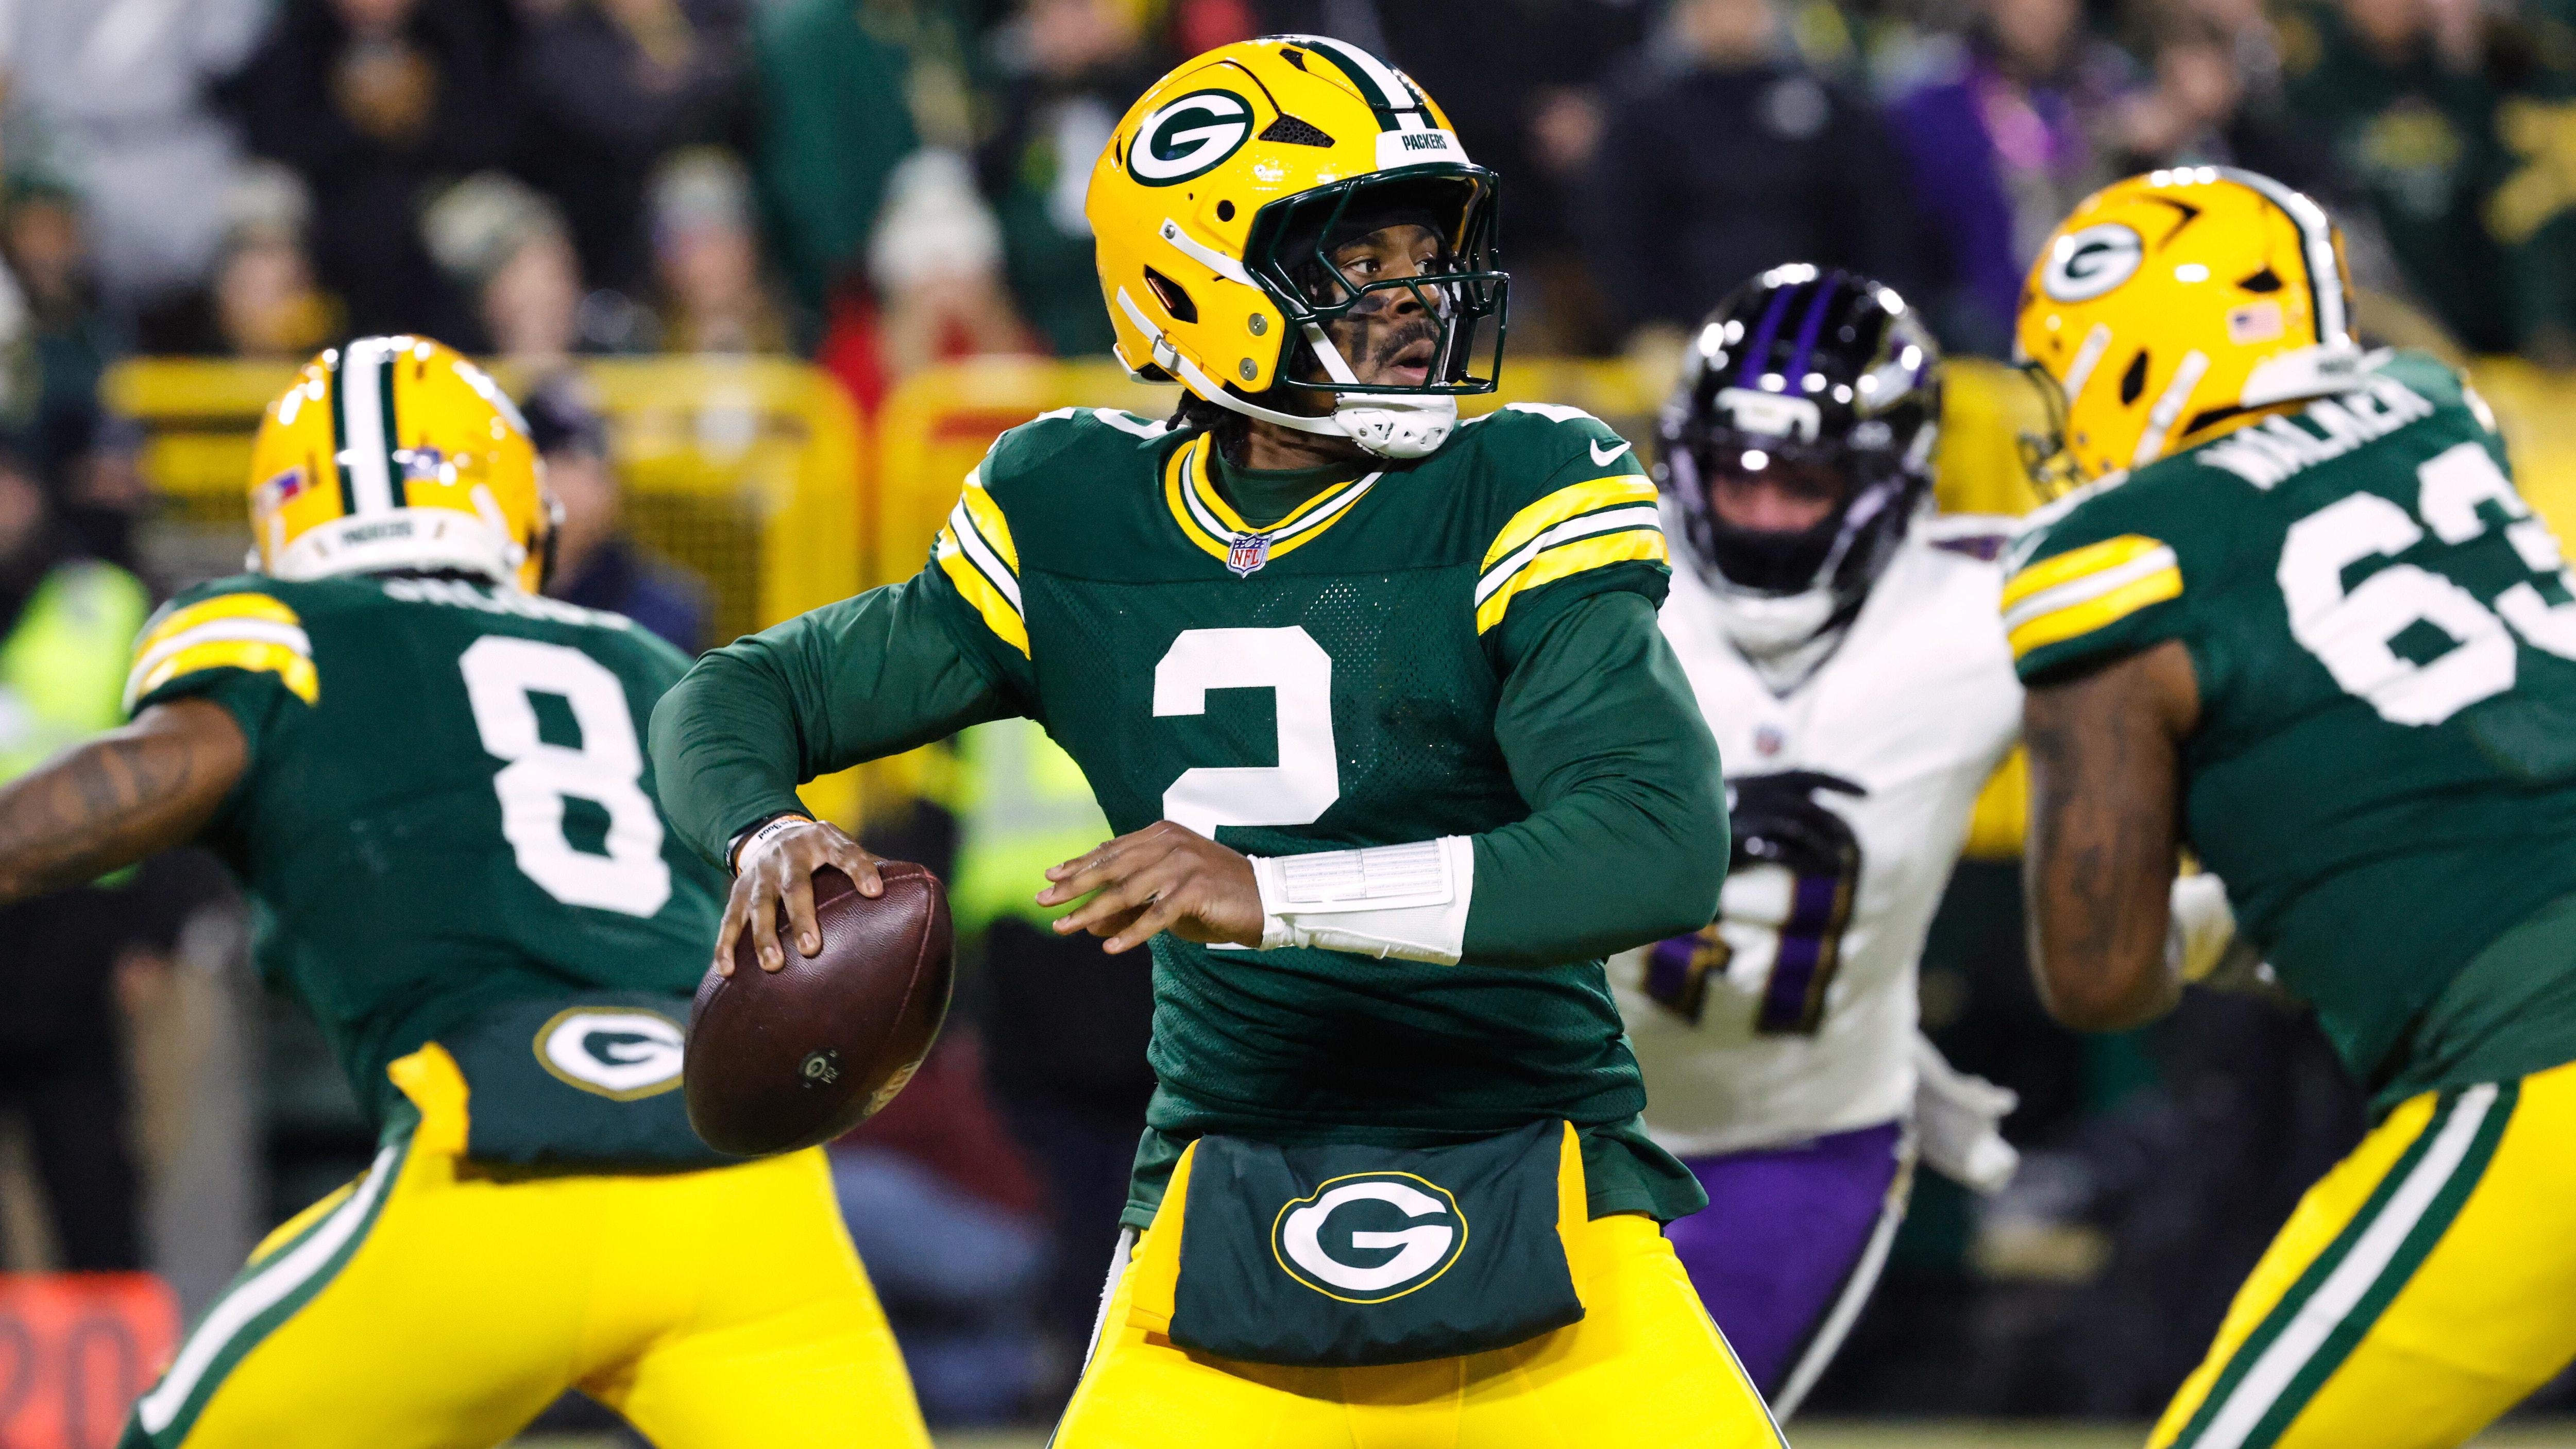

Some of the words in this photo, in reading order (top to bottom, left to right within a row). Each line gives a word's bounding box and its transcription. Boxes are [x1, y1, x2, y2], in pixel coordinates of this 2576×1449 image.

[1130, 94, 1246, 179] G
[1401, 134, 1447, 150] PACKERS
[2044, 223, 2143, 302] G
[1232, 549, 1259, 567] NFL
[2276, 440, 2576, 727] 63
[459, 635, 671, 919] 8
[1153, 625, 1340, 950] 2
[546, 1014, 685, 1091] G
[1283, 1182, 1453, 1291] G
